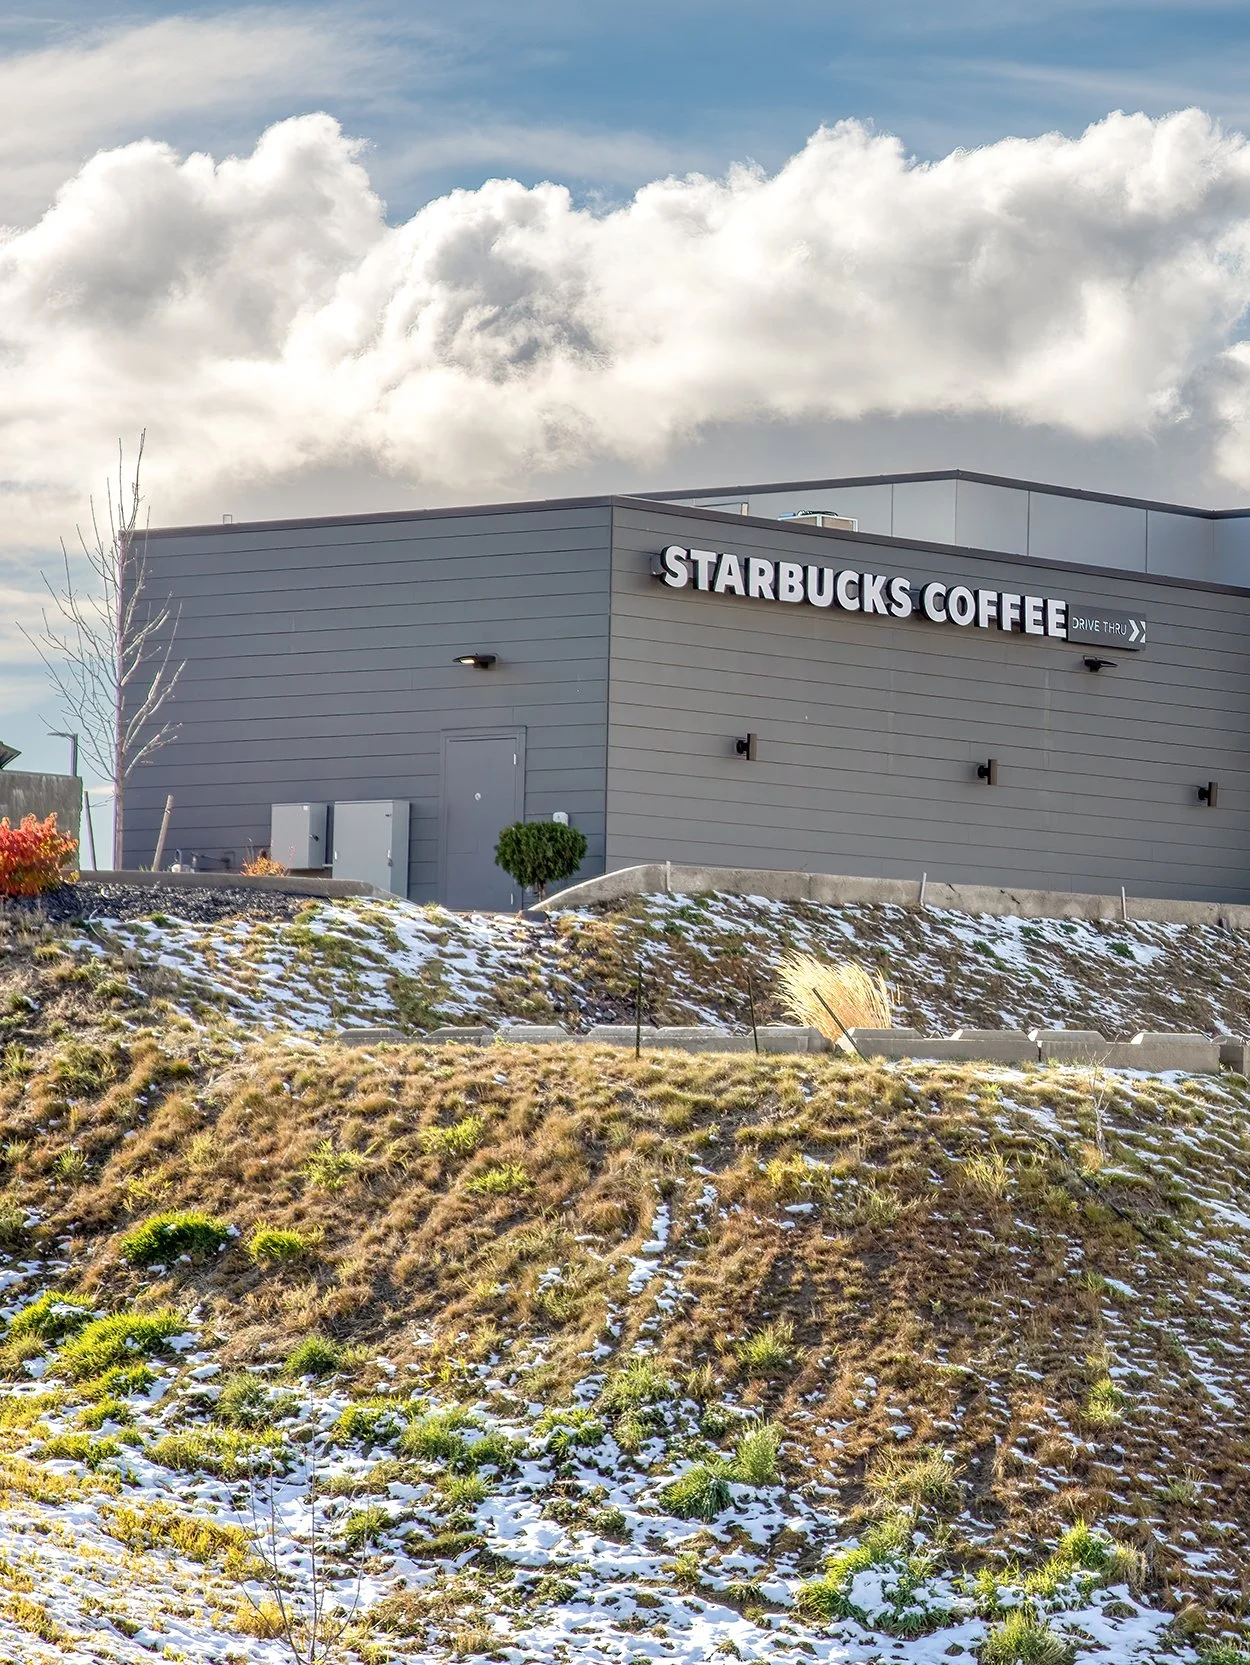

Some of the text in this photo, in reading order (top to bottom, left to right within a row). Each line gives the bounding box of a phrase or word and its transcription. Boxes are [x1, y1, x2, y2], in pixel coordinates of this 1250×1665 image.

[663, 544, 1067, 638] STARBUCKS COFFEE
[1072, 617, 1127, 635] DRIVE THRU
